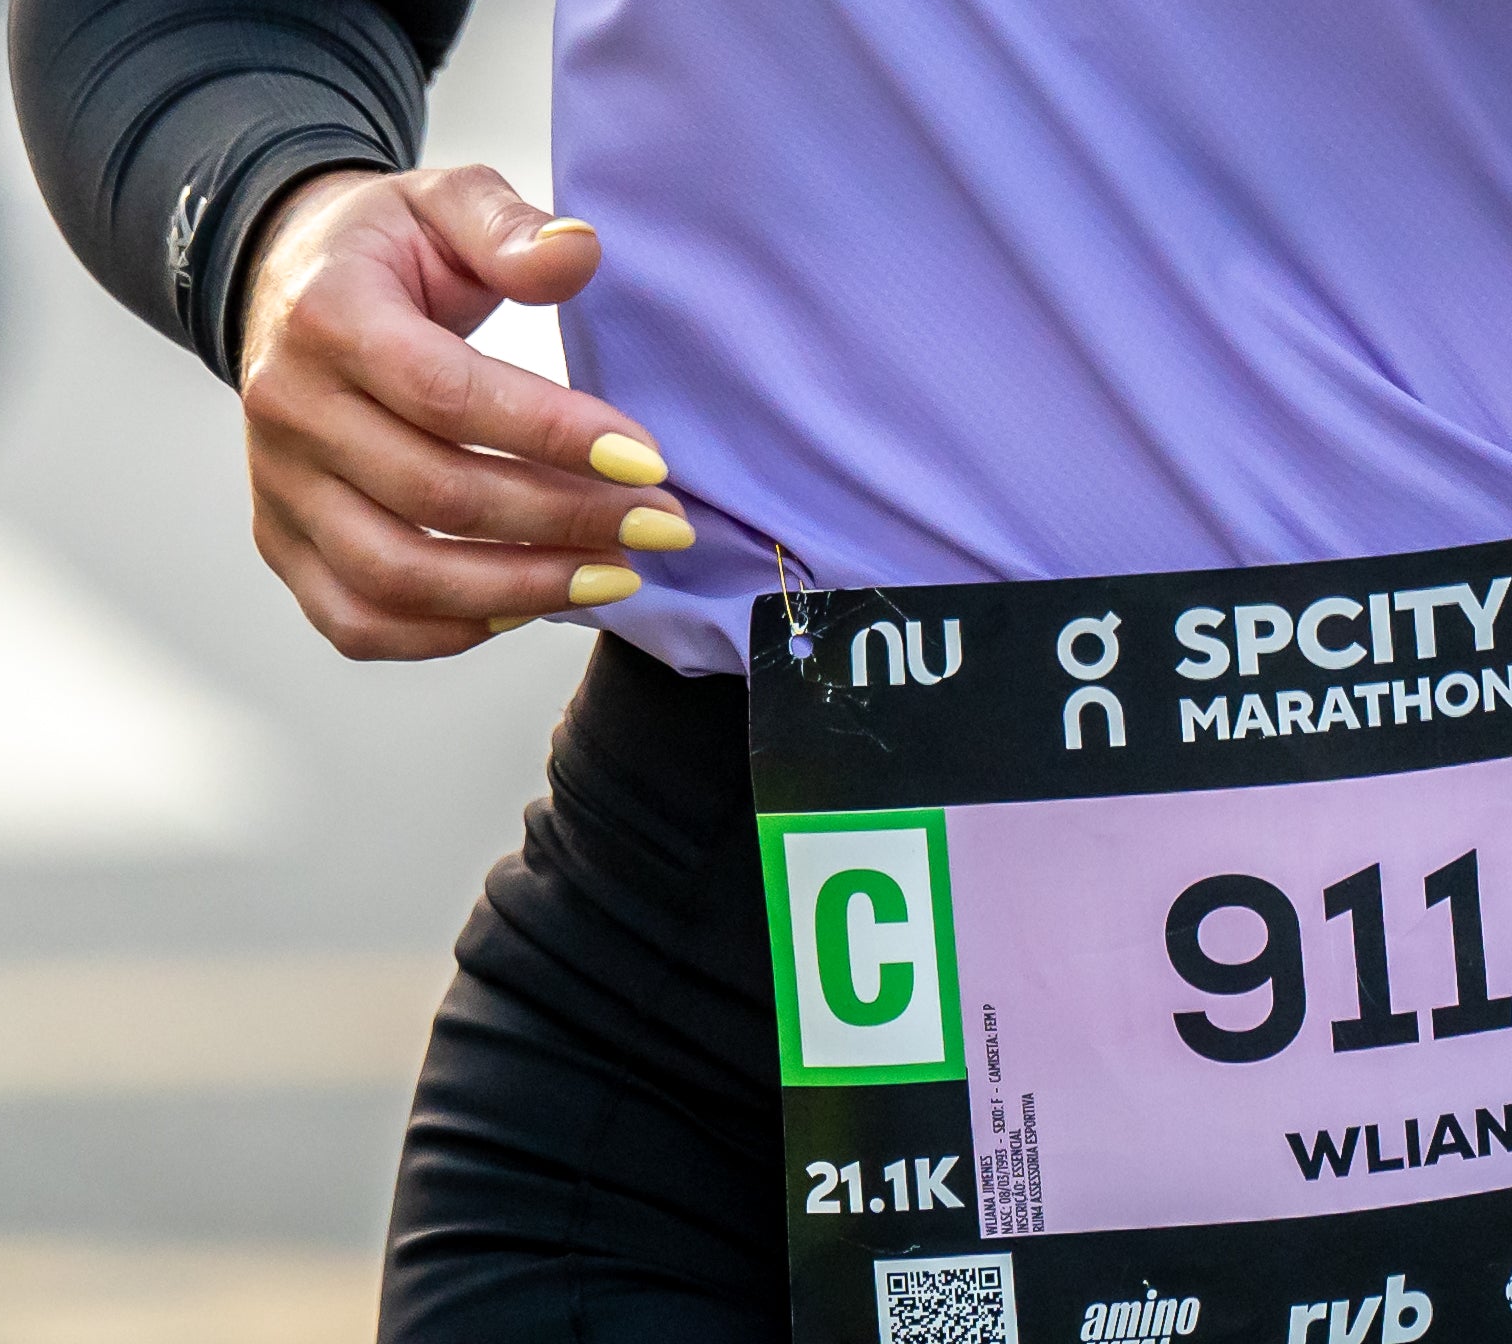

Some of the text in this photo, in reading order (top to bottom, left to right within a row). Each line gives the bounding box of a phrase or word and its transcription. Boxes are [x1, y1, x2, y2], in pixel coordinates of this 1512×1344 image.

[814, 867, 917, 1027] C
[984, 1012, 996, 1032] FEM
[986, 1034, 1001, 1083] CAMISETA:
[992, 1106, 1006, 1134] SEXO:
[1021, 1093, 1037, 1145] ESPORTIVA
[1009, 1128, 1024, 1177] ESSENCIAL
[1025, 1146, 1042, 1203] ASSESSORIA
[804, 1154, 965, 1215] 21.1K
[980, 1155, 998, 1235] WLIANA JIMENES
[1080, 1288, 1201, 1342] amino
[1289, 1274, 1433, 1344] rvb
